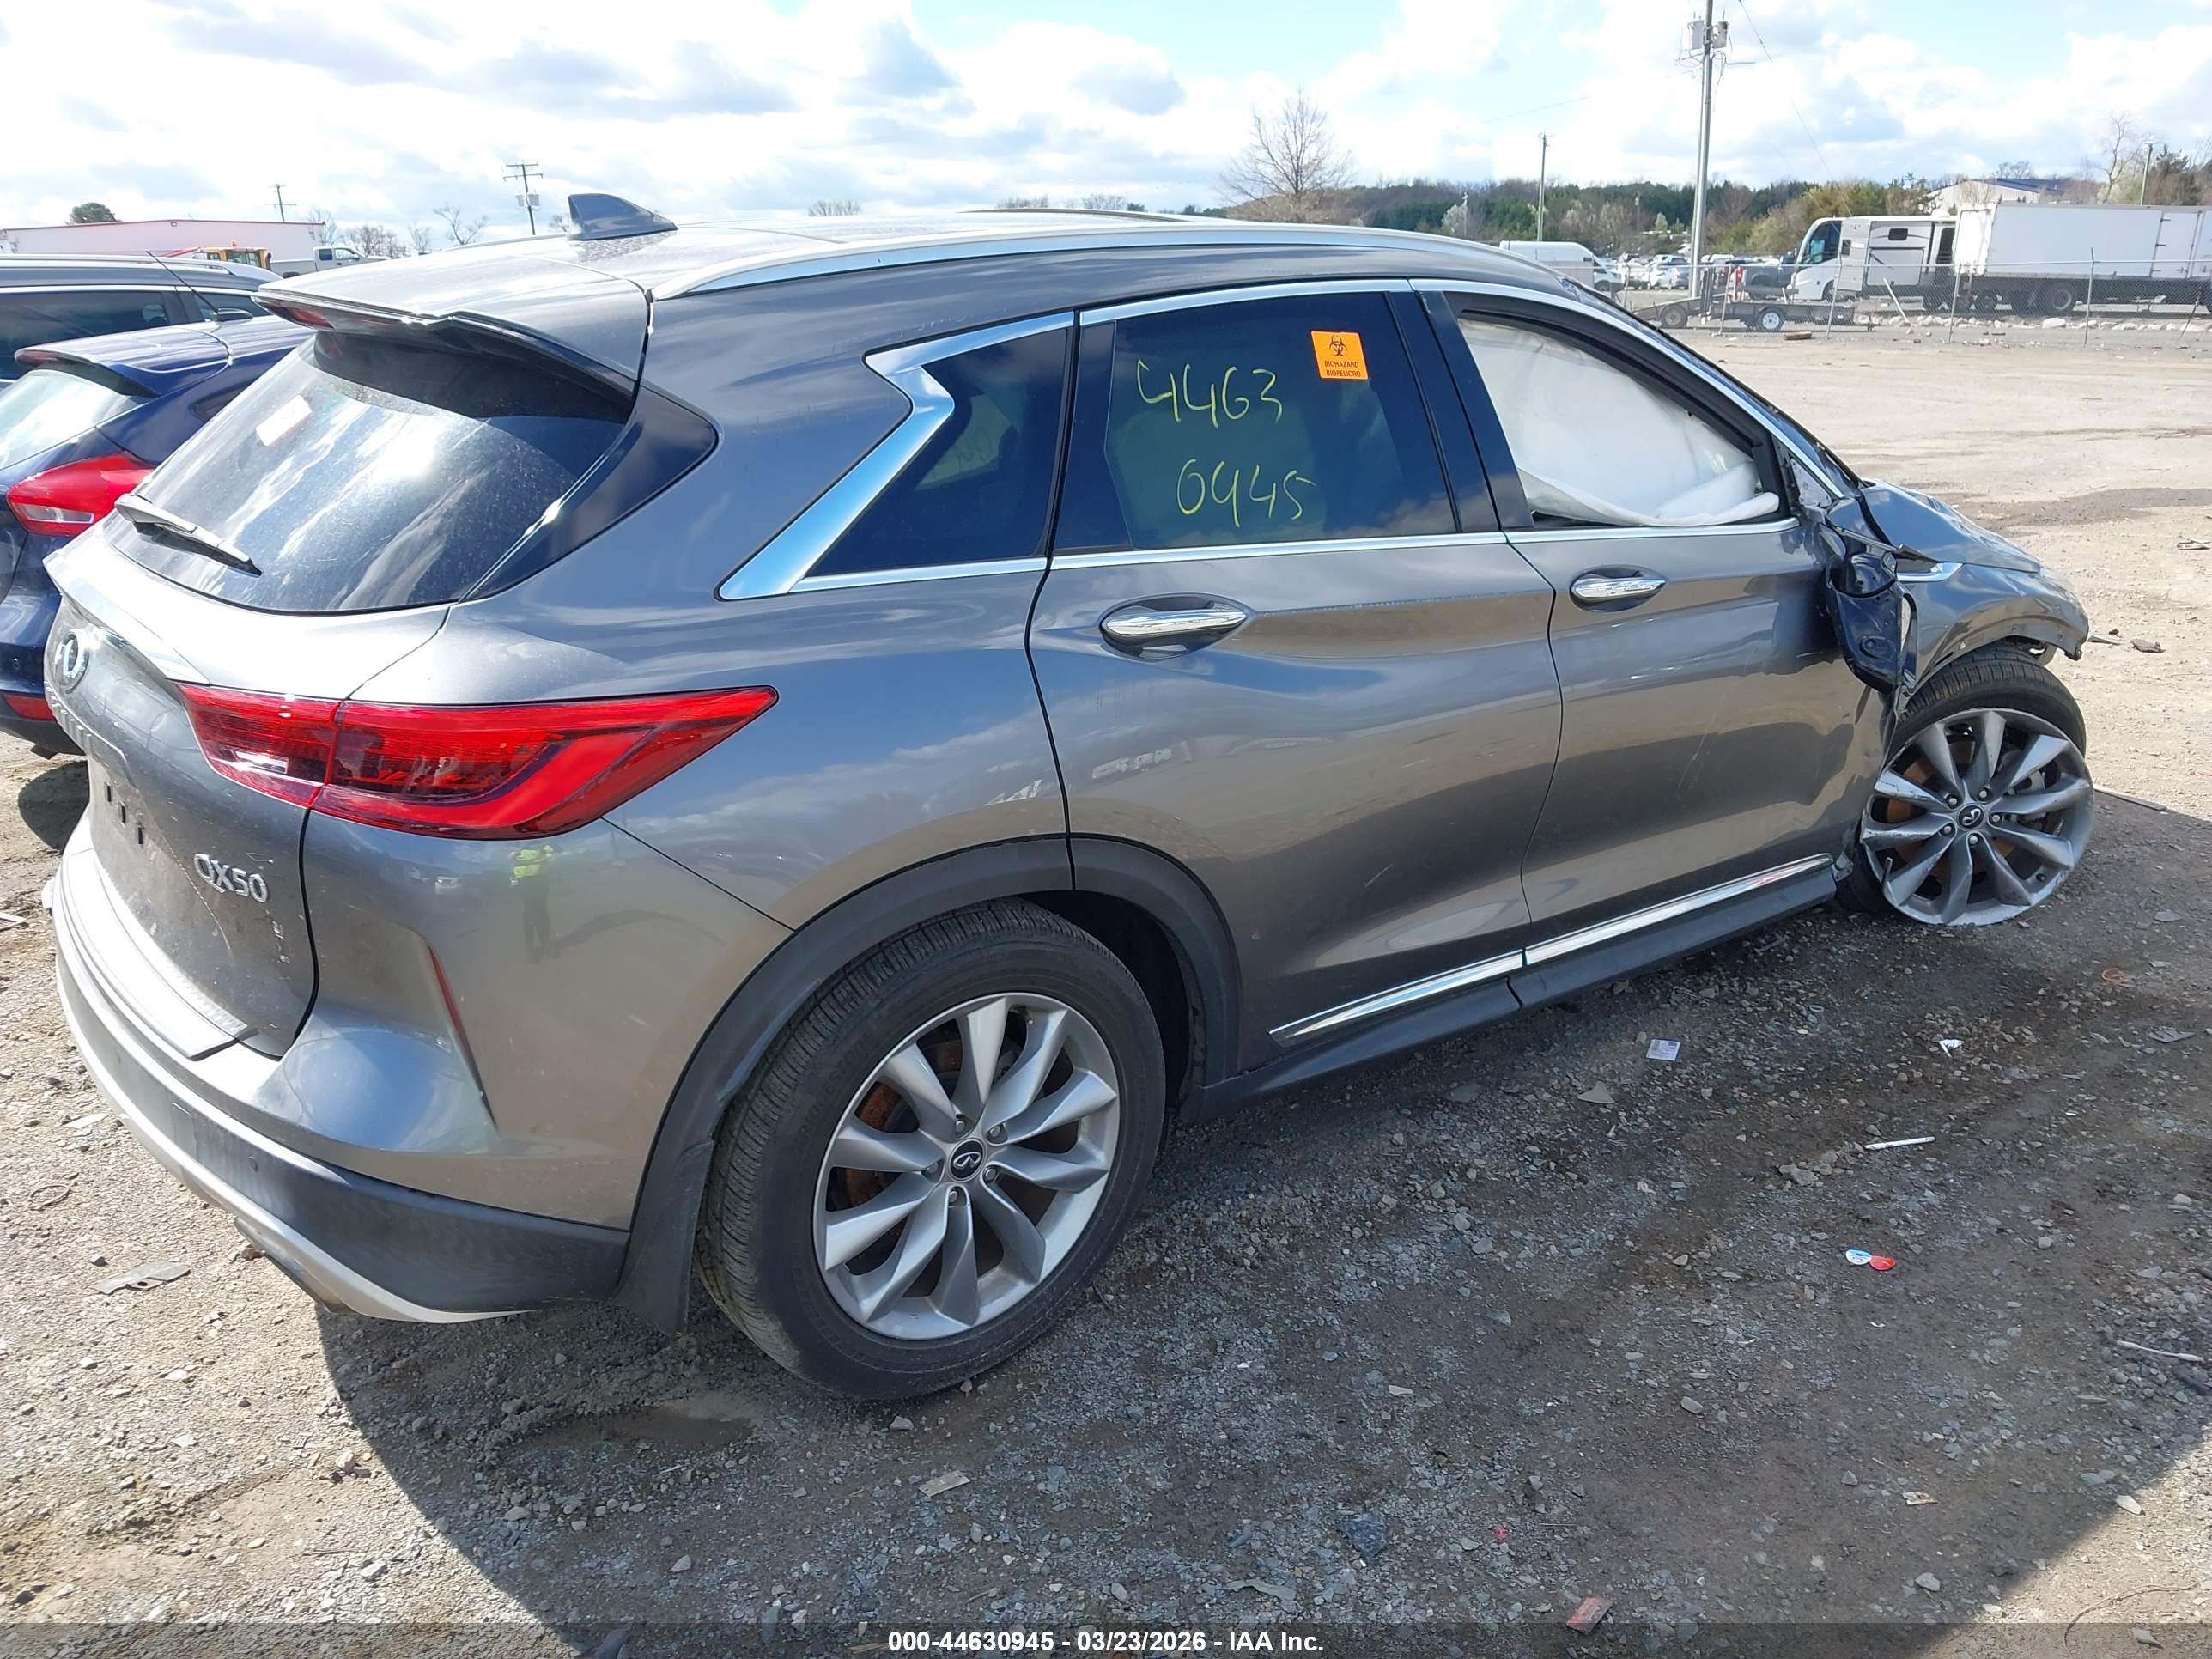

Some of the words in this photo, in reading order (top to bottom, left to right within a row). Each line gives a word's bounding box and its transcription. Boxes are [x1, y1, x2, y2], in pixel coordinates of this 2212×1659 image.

[1323, 360, 1359, 368] BIOHAZARD
[1326, 369, 1361, 378] BIOPELIGRO
[1137, 359, 1282, 428] 4463
[193, 853, 269, 902] QX50
